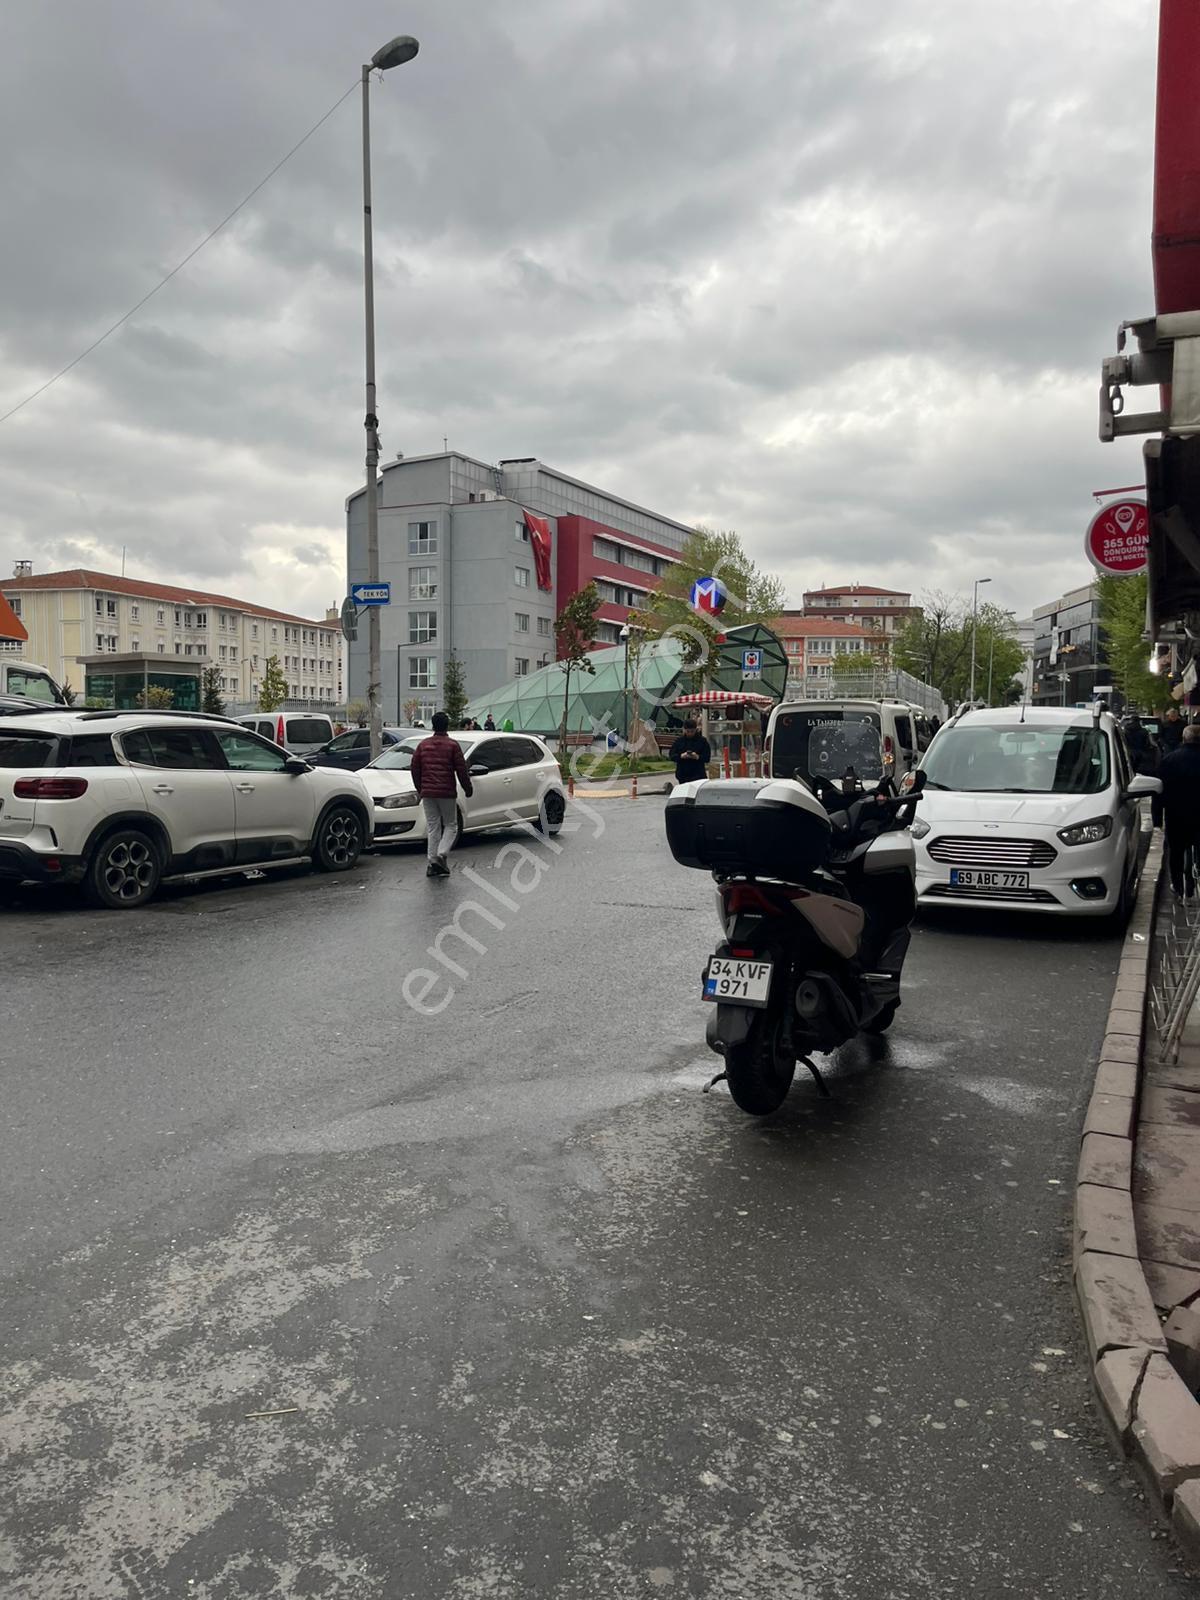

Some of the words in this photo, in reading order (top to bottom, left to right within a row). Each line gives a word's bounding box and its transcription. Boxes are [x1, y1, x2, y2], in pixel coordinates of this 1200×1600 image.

[1103, 537, 1123, 549] 365
[1126, 533, 1149, 546] GÜN
[1103, 545, 1147, 556] DONDURM
[958, 872, 972, 884] 69
[977, 873, 999, 885] ABC
[1003, 874, 1025, 887] 772
[711, 960, 731, 977] 34
[735, 963, 769, 980] KVF
[720, 979, 748, 996] 971
